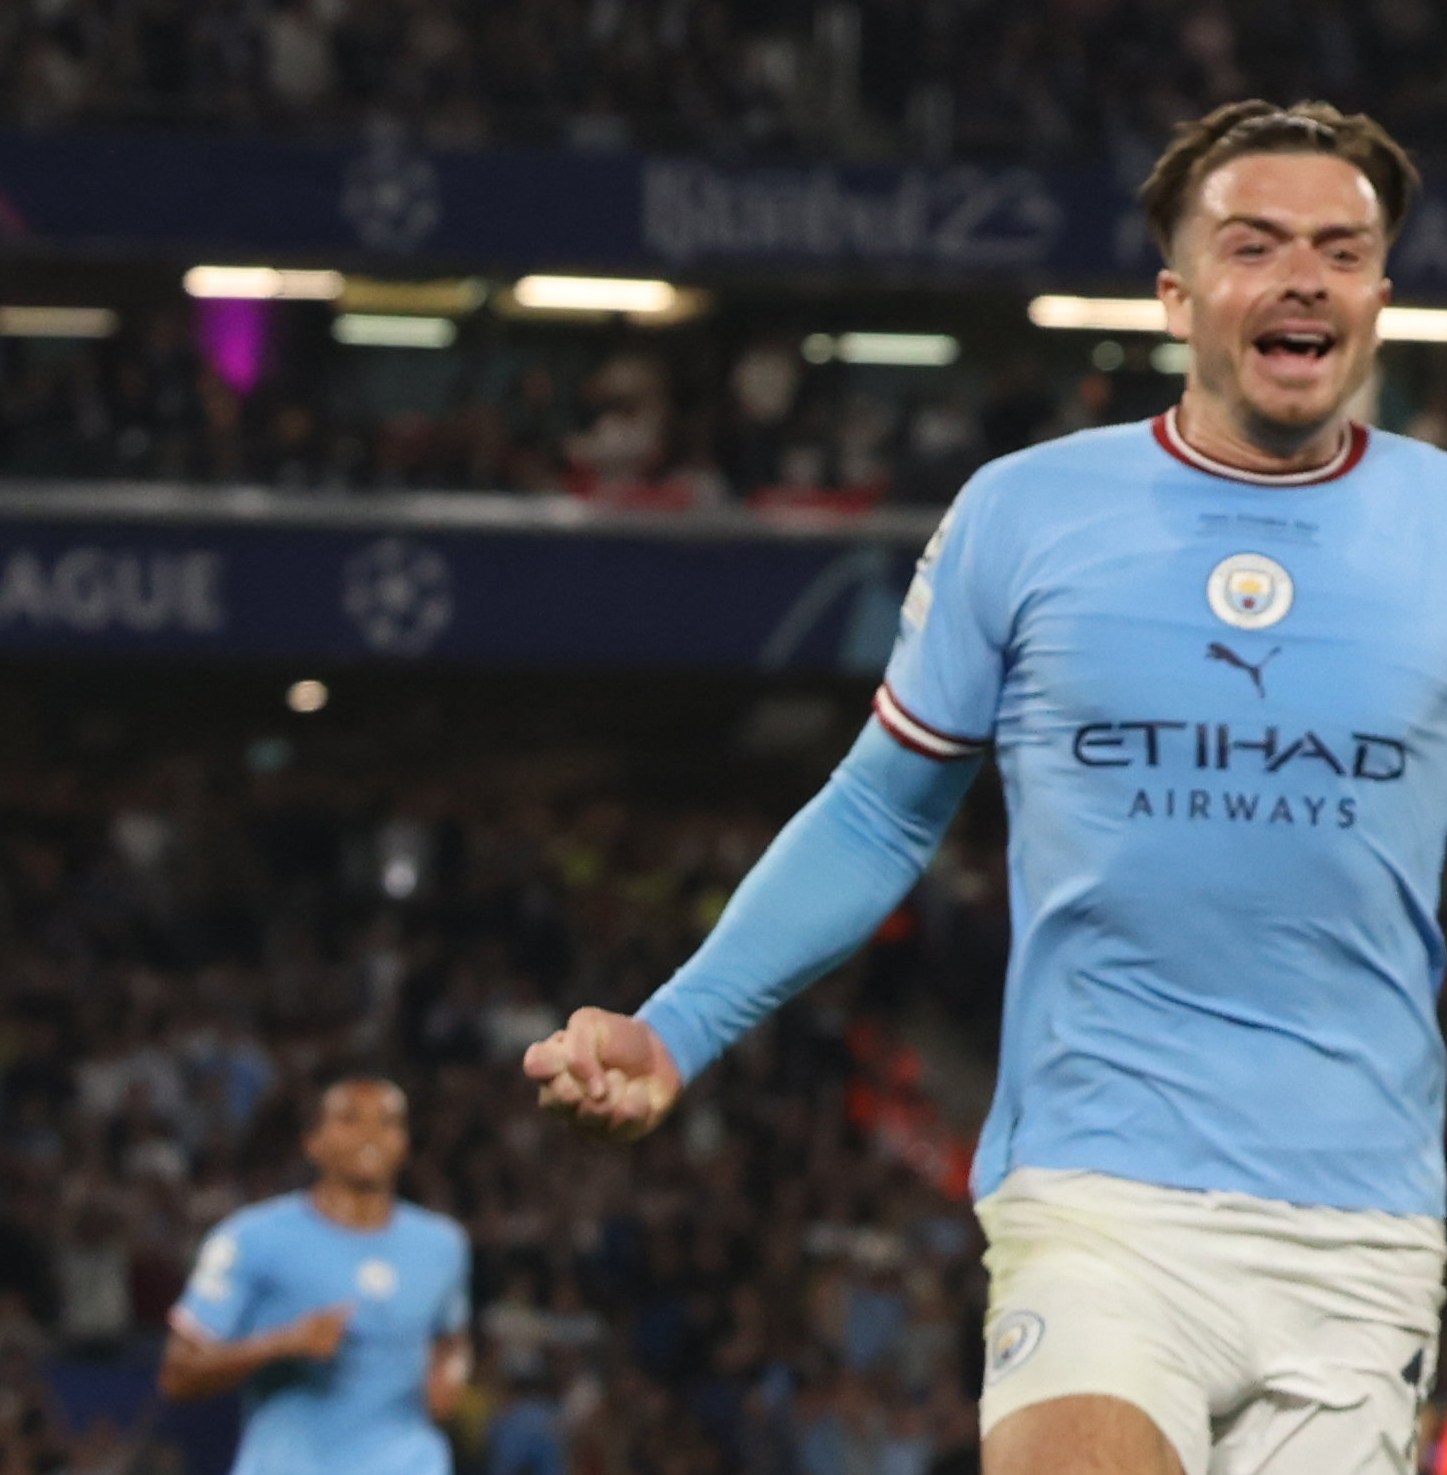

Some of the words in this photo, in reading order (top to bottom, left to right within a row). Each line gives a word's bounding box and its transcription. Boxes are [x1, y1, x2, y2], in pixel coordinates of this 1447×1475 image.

[0, 545, 224, 632] AGUE
[1072, 720, 1406, 782] ETIHAD
[1127, 788, 1358, 829] AIRWAYS
